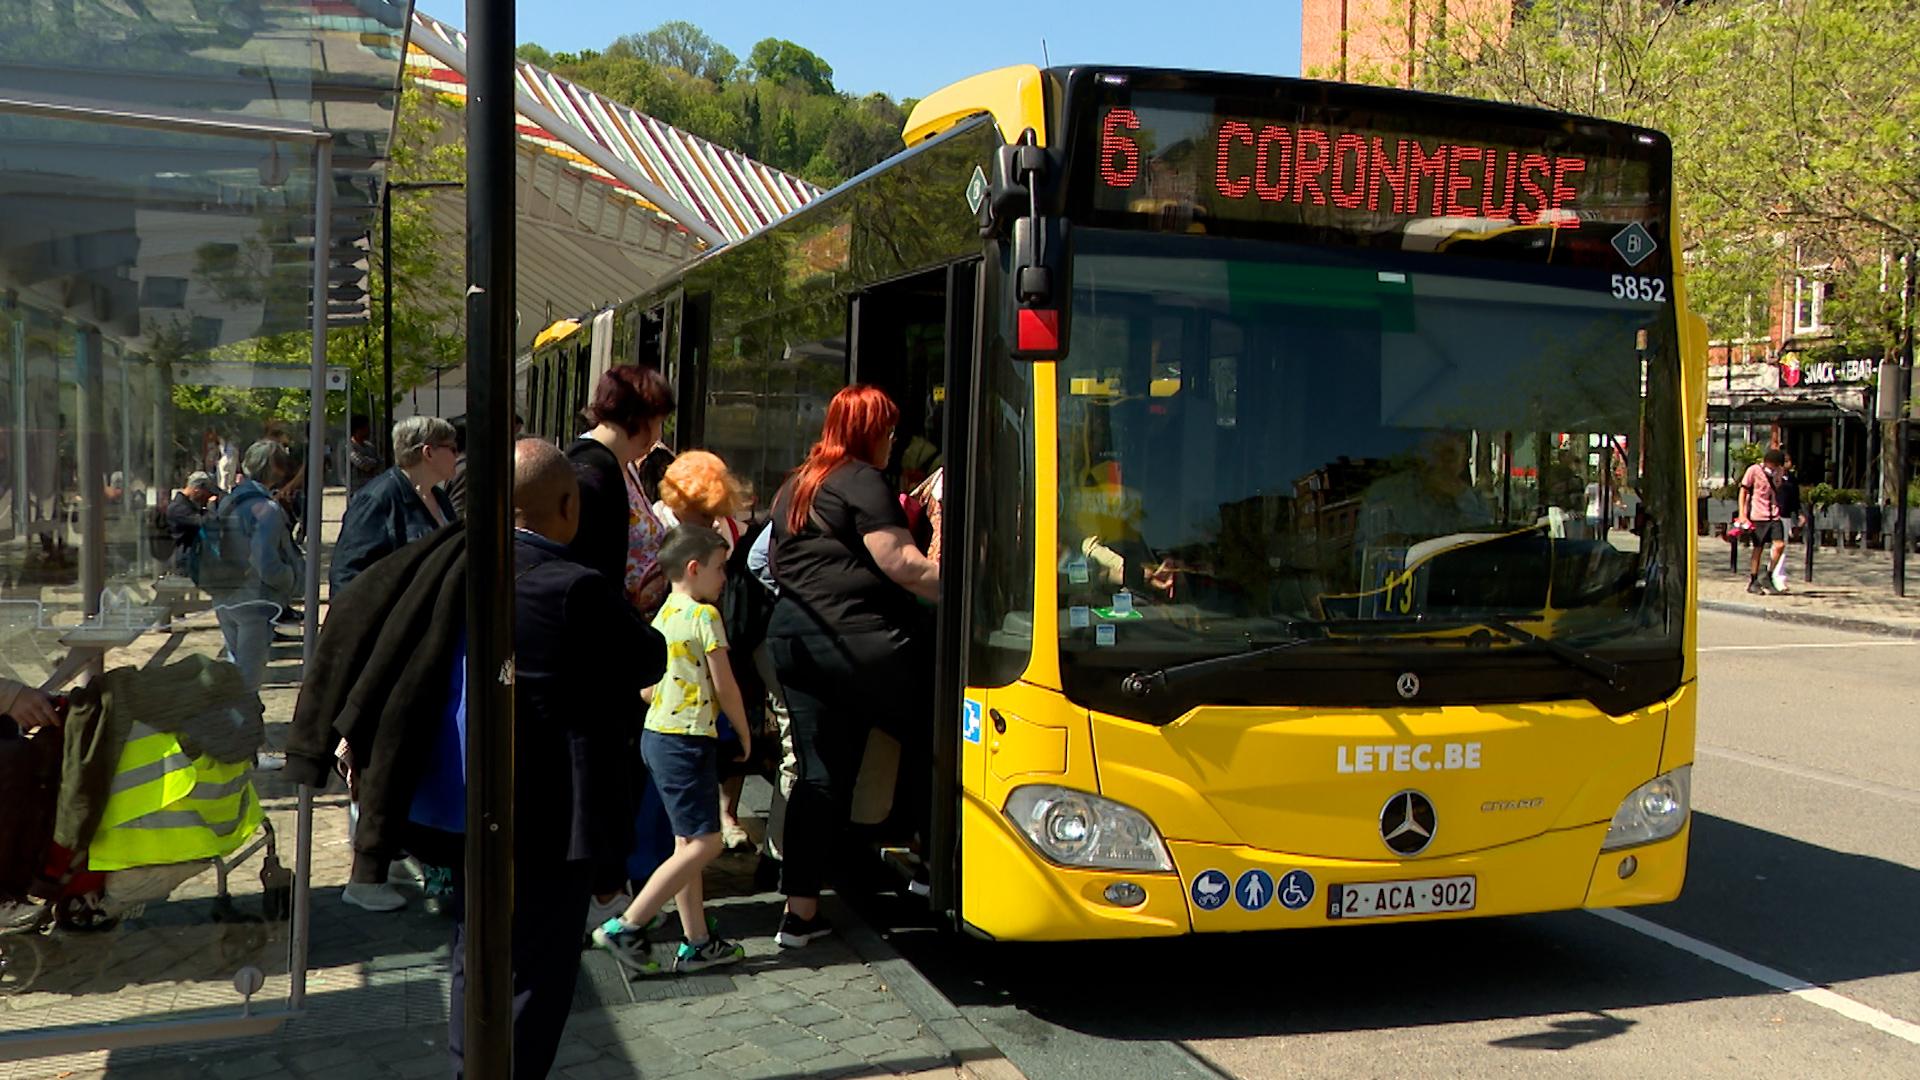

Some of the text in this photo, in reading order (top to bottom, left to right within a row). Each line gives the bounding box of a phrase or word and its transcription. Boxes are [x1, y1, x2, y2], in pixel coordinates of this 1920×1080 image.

[1101, 107, 1586, 229] 6 CORONMEUSE
[1612, 274, 1666, 303] 5852
[1337, 743, 1481, 773] LETEC.BE
